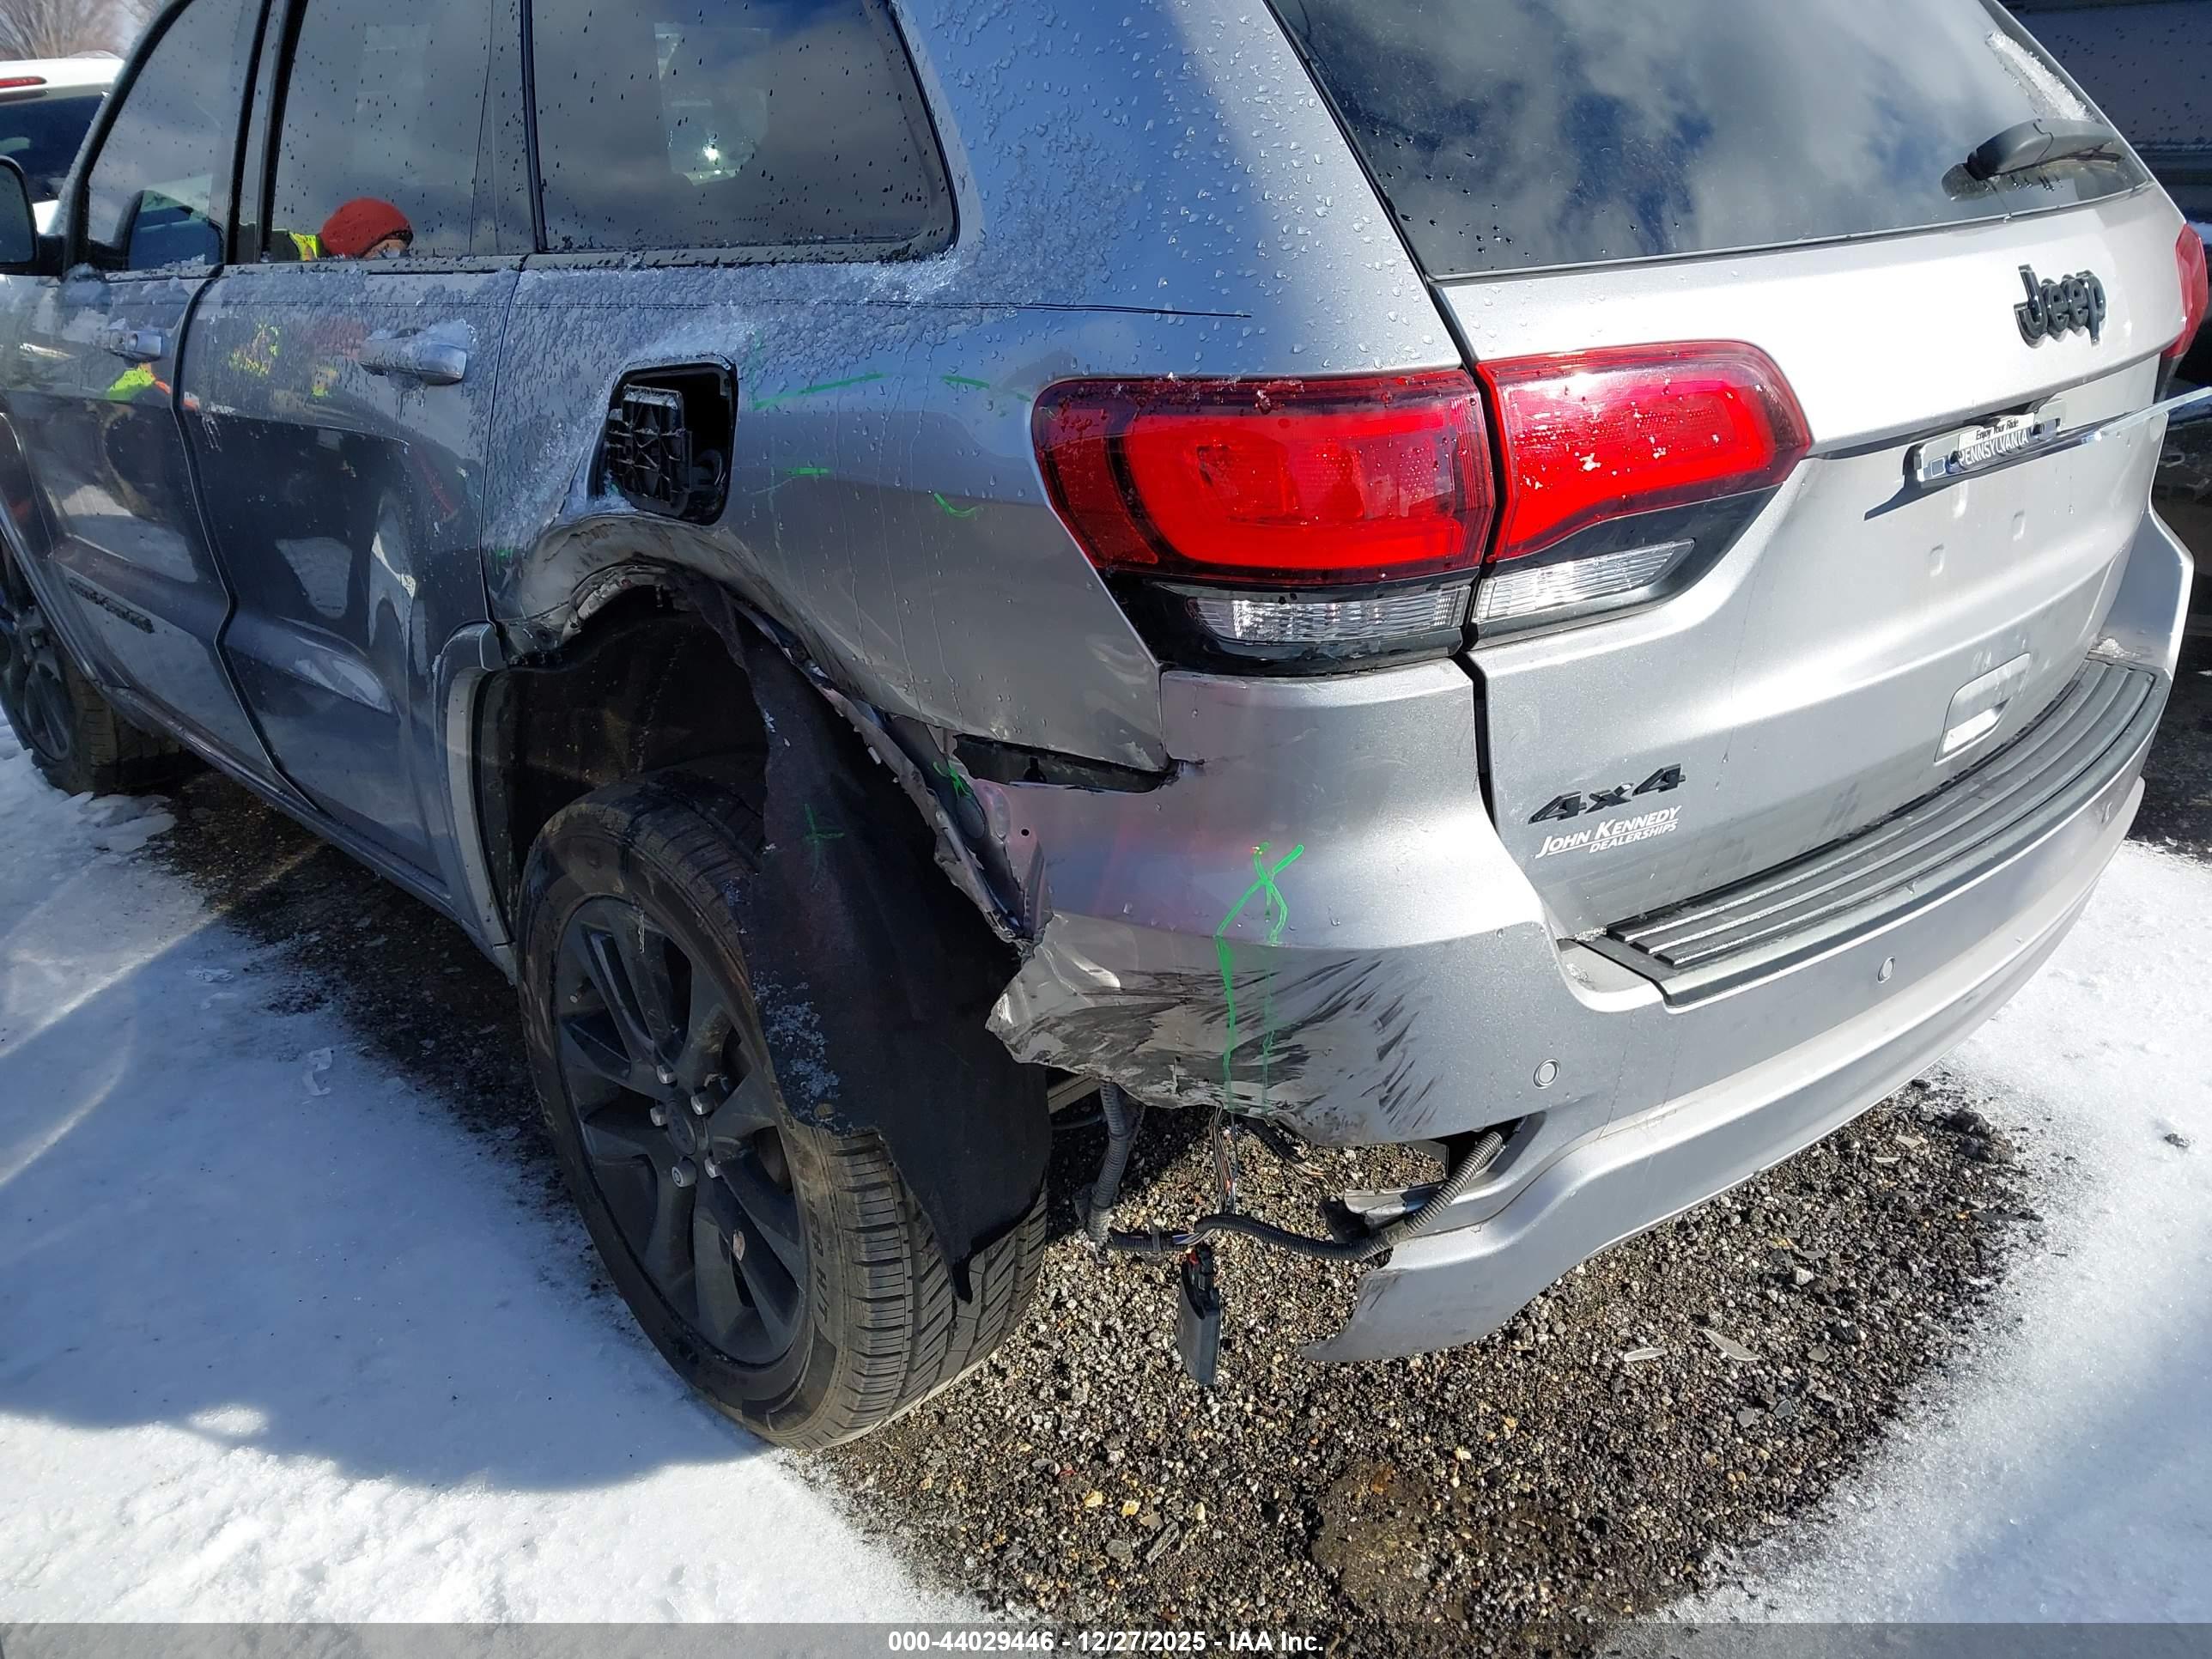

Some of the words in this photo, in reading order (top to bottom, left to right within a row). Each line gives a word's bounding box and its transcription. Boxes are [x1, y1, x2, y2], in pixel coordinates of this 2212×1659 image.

[2014, 263, 2106, 348] Jeep
[1958, 428, 2029, 465] PENNSYLVANIA
[1977, 428, 1992, 441] Enjoy
[2007, 418, 2019, 429] Ride
[1589, 821, 1679, 854] DEALERSHIPS
